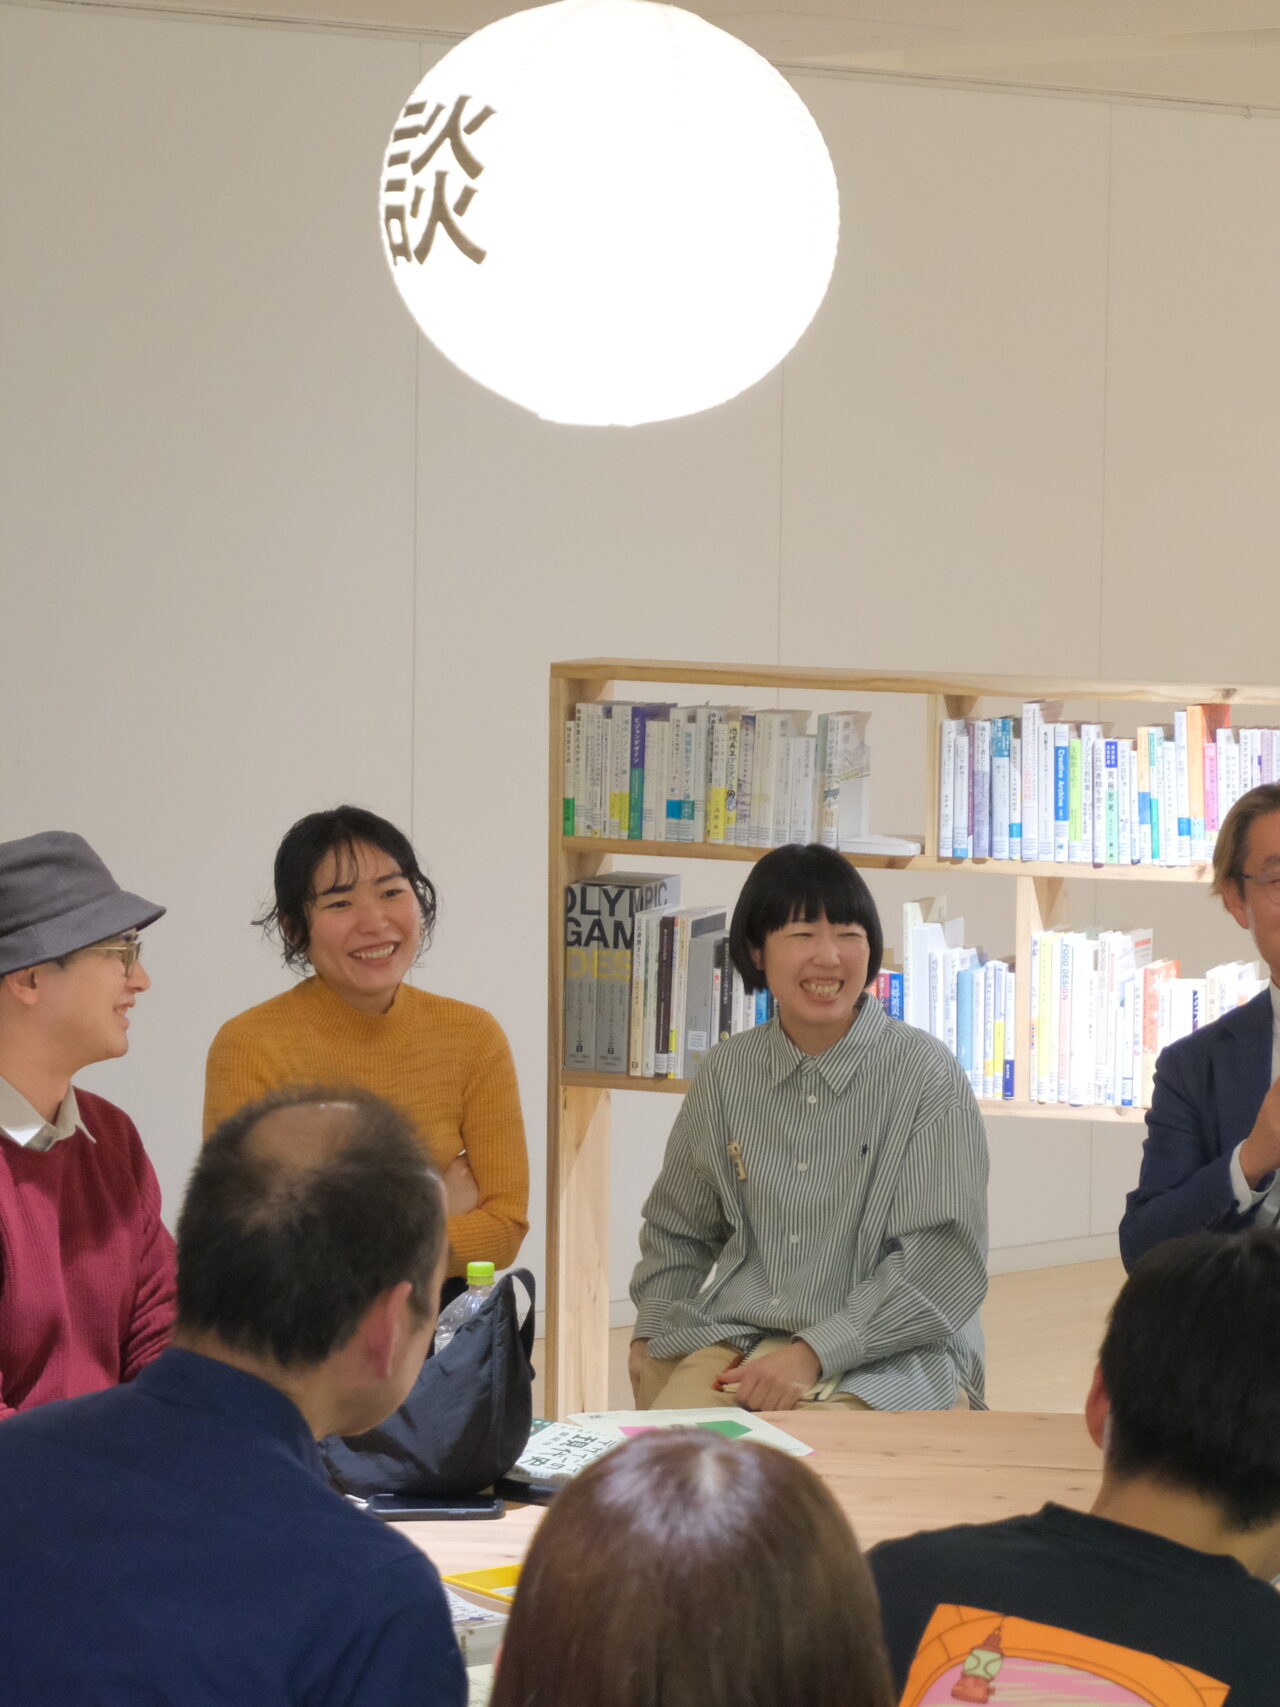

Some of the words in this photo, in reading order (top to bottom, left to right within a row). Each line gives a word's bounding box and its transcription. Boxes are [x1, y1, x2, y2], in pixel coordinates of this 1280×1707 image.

[382, 94, 498, 267] 談
[566, 917, 634, 949] GAM
[566, 948, 631, 981] DES
